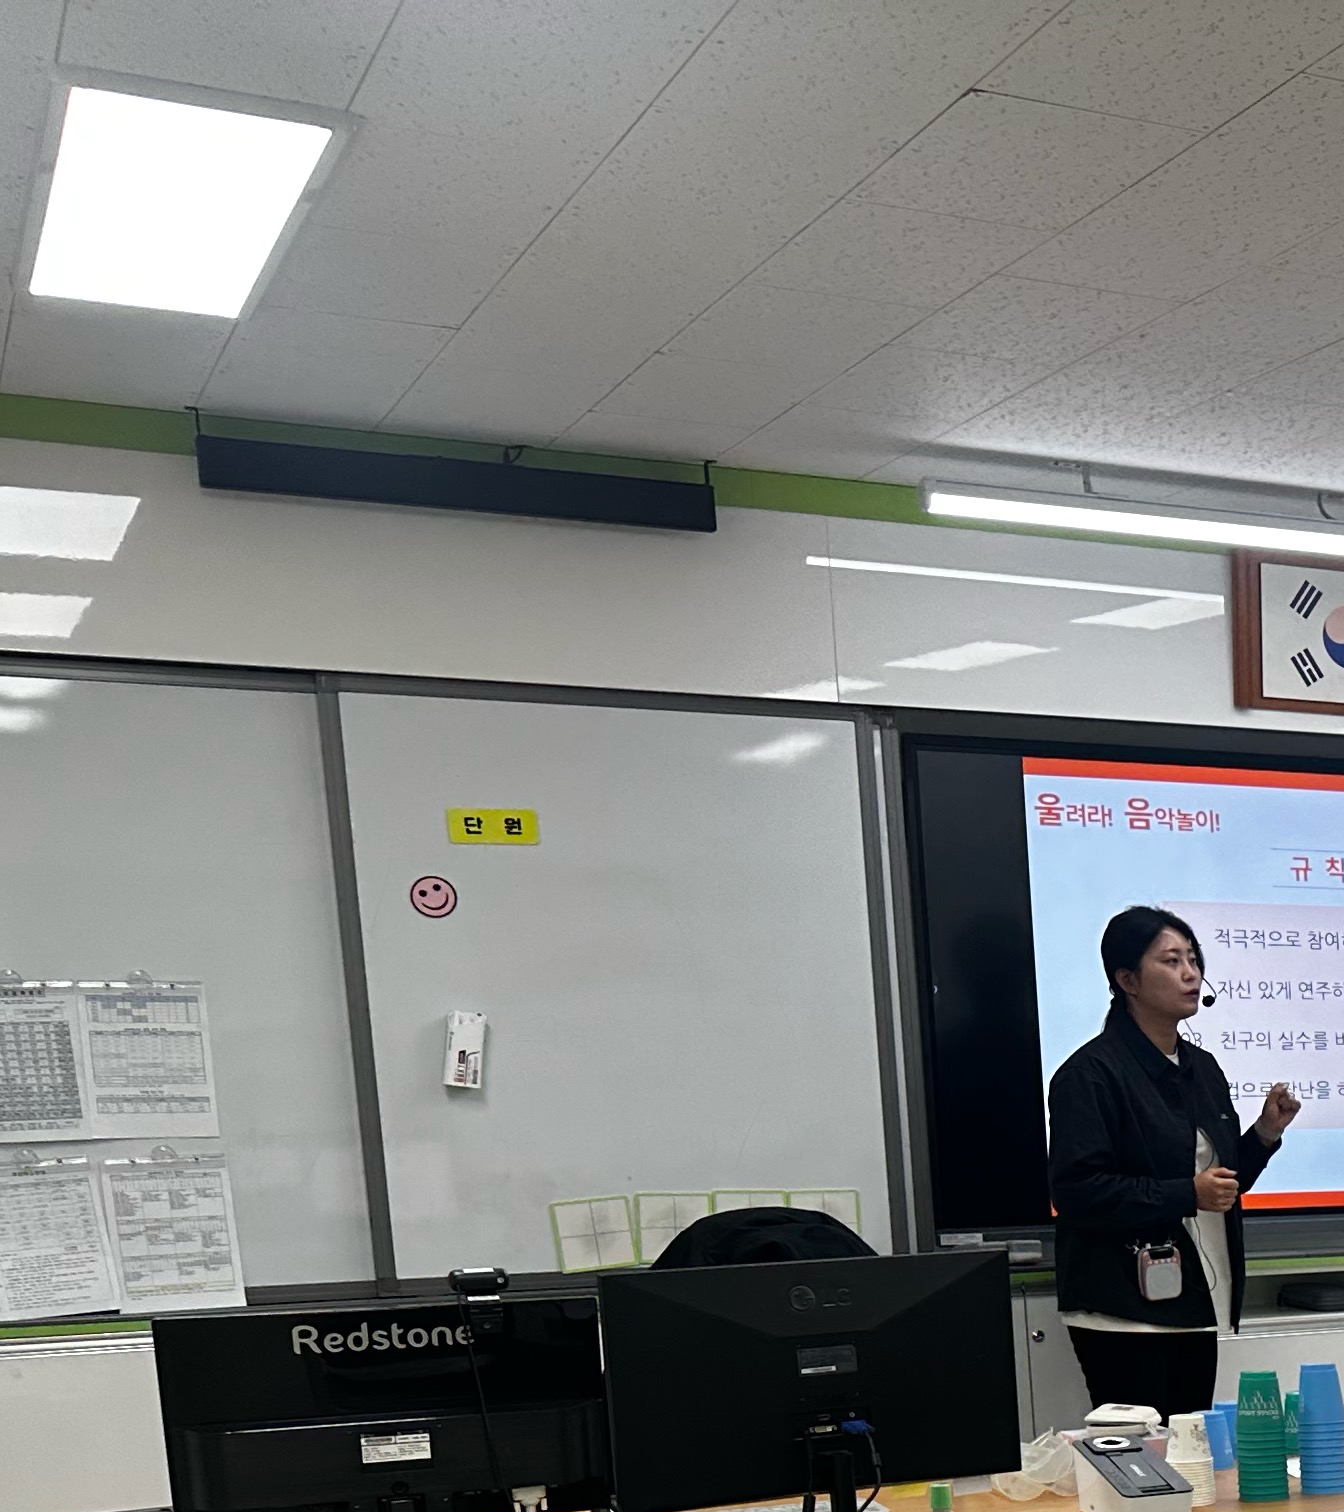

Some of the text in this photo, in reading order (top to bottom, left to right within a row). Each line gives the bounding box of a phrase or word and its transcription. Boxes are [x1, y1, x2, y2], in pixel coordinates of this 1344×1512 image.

[1034, 792, 1221, 834] 울려라! 음악놀이!
[463, 816, 522, 836] 단 원
[1214, 928, 1301, 949] 적극적으로
[1217, 979, 1252, 1000] 자신
[1258, 979, 1292, 1000] 있게
[1220, 1030, 1272, 1051] 친구의
[1278, 1030, 1329, 1051] 실수를
[290, 1321, 476, 1356] Redstone
